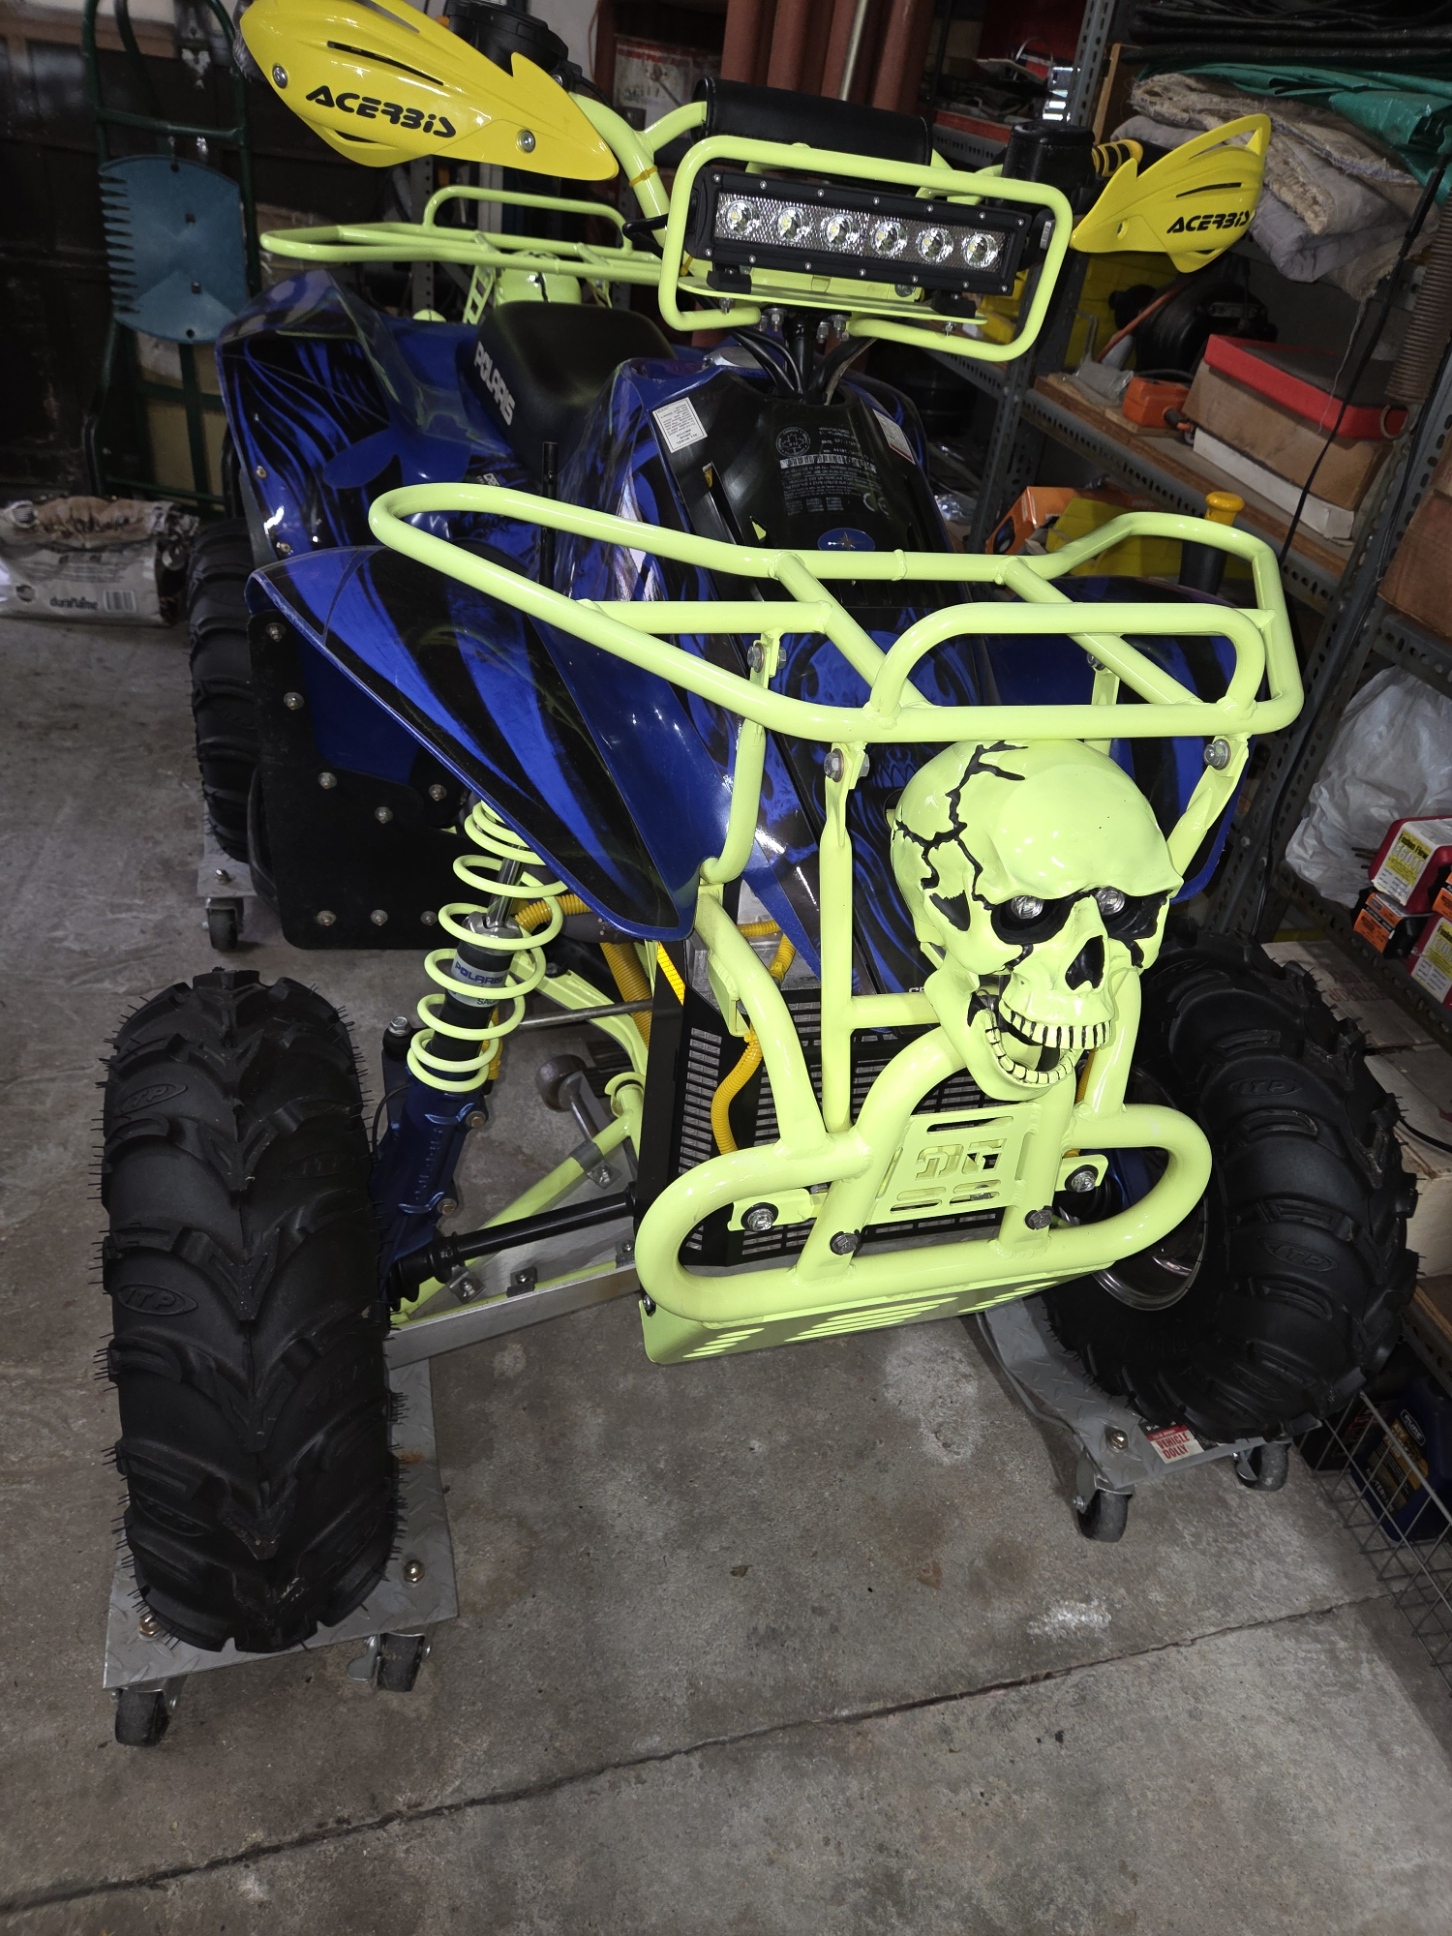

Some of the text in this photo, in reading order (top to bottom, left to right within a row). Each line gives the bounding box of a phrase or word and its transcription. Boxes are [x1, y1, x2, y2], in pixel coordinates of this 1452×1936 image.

[306, 85, 457, 139] ACERBIS
[1166, 211, 1250, 234] ACERBIS
[473, 340, 517, 427] POLARIS
[455, 960, 505, 986] POLARIS
[125, 1287, 177, 1310] ITP
[1156, 1433, 1190, 1449] VEHICLE
[1162, 1446, 1188, 1459] DOLLY
